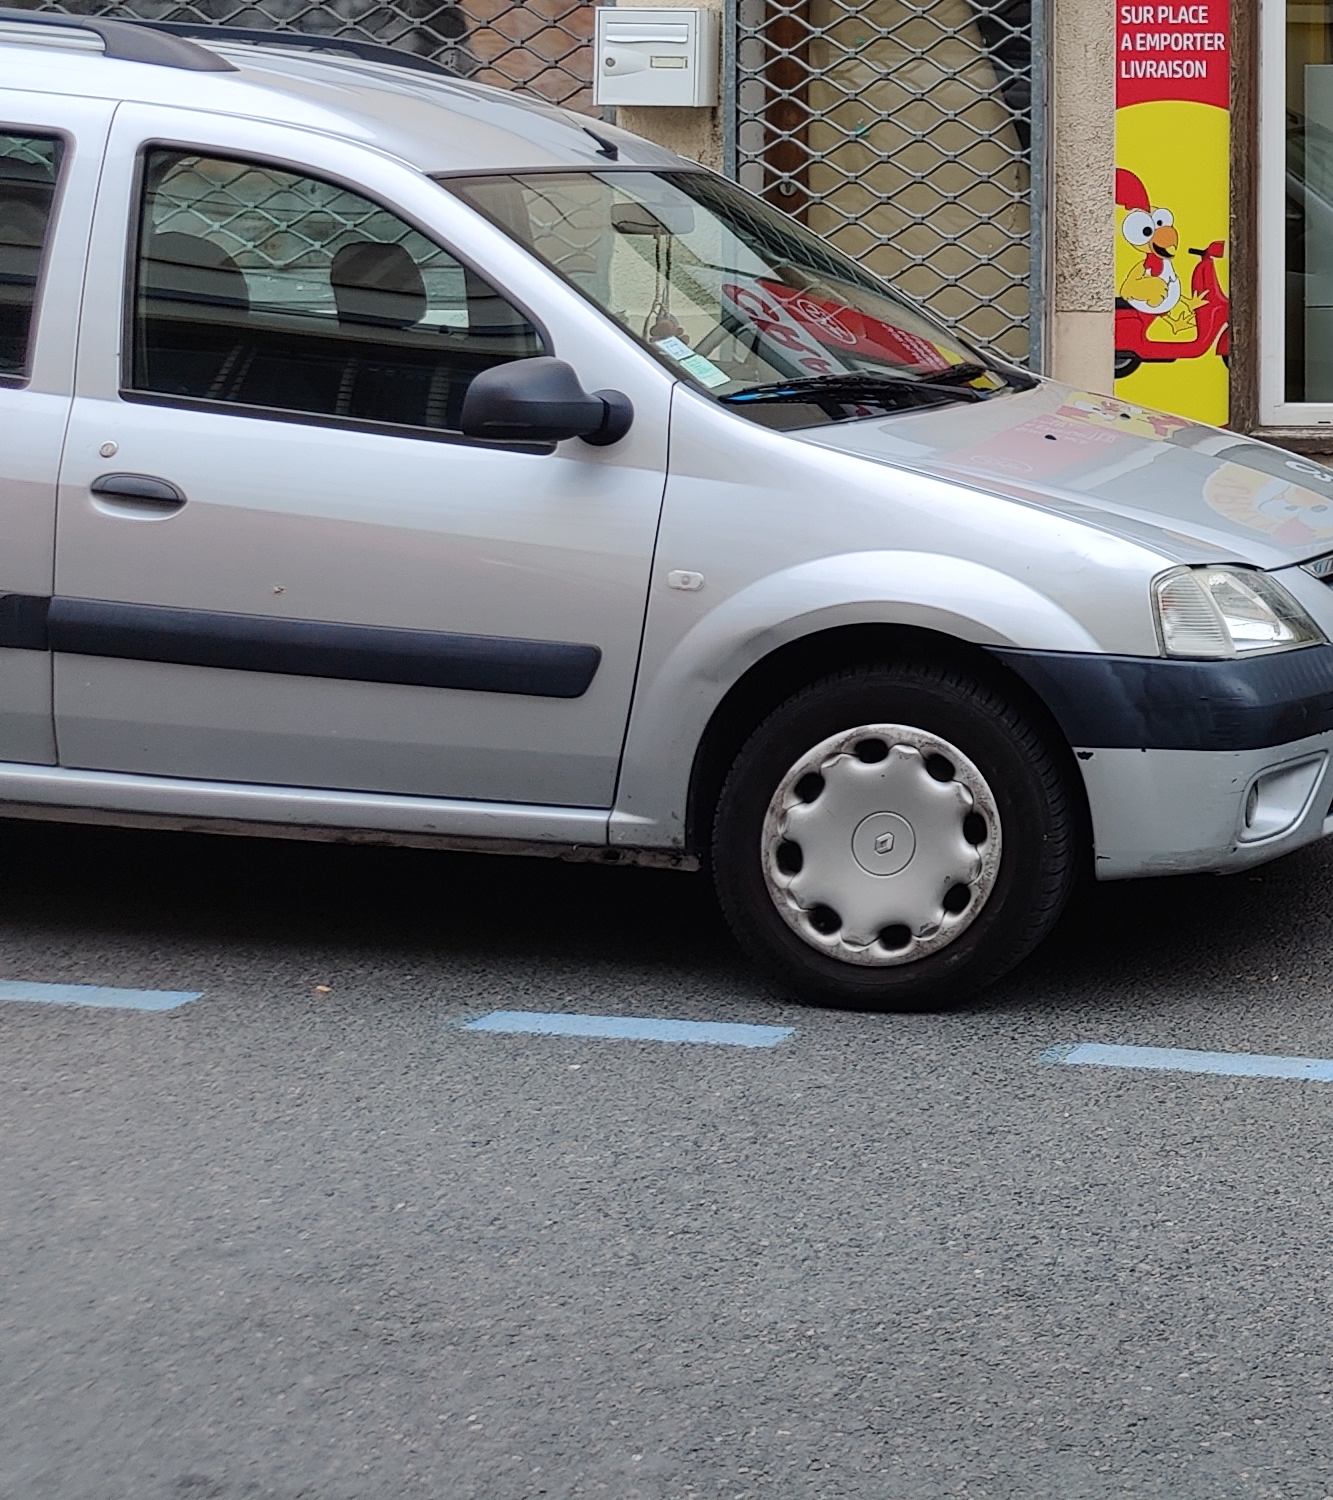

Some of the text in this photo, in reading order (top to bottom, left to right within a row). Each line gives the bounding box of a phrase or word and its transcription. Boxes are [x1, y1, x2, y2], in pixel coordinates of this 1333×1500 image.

[1121, 5, 1209, 24] SUR PLACE
[1121, 32, 1225, 51] A EMPORTER
[1121, 60, 1207, 79] LIVRAISON
